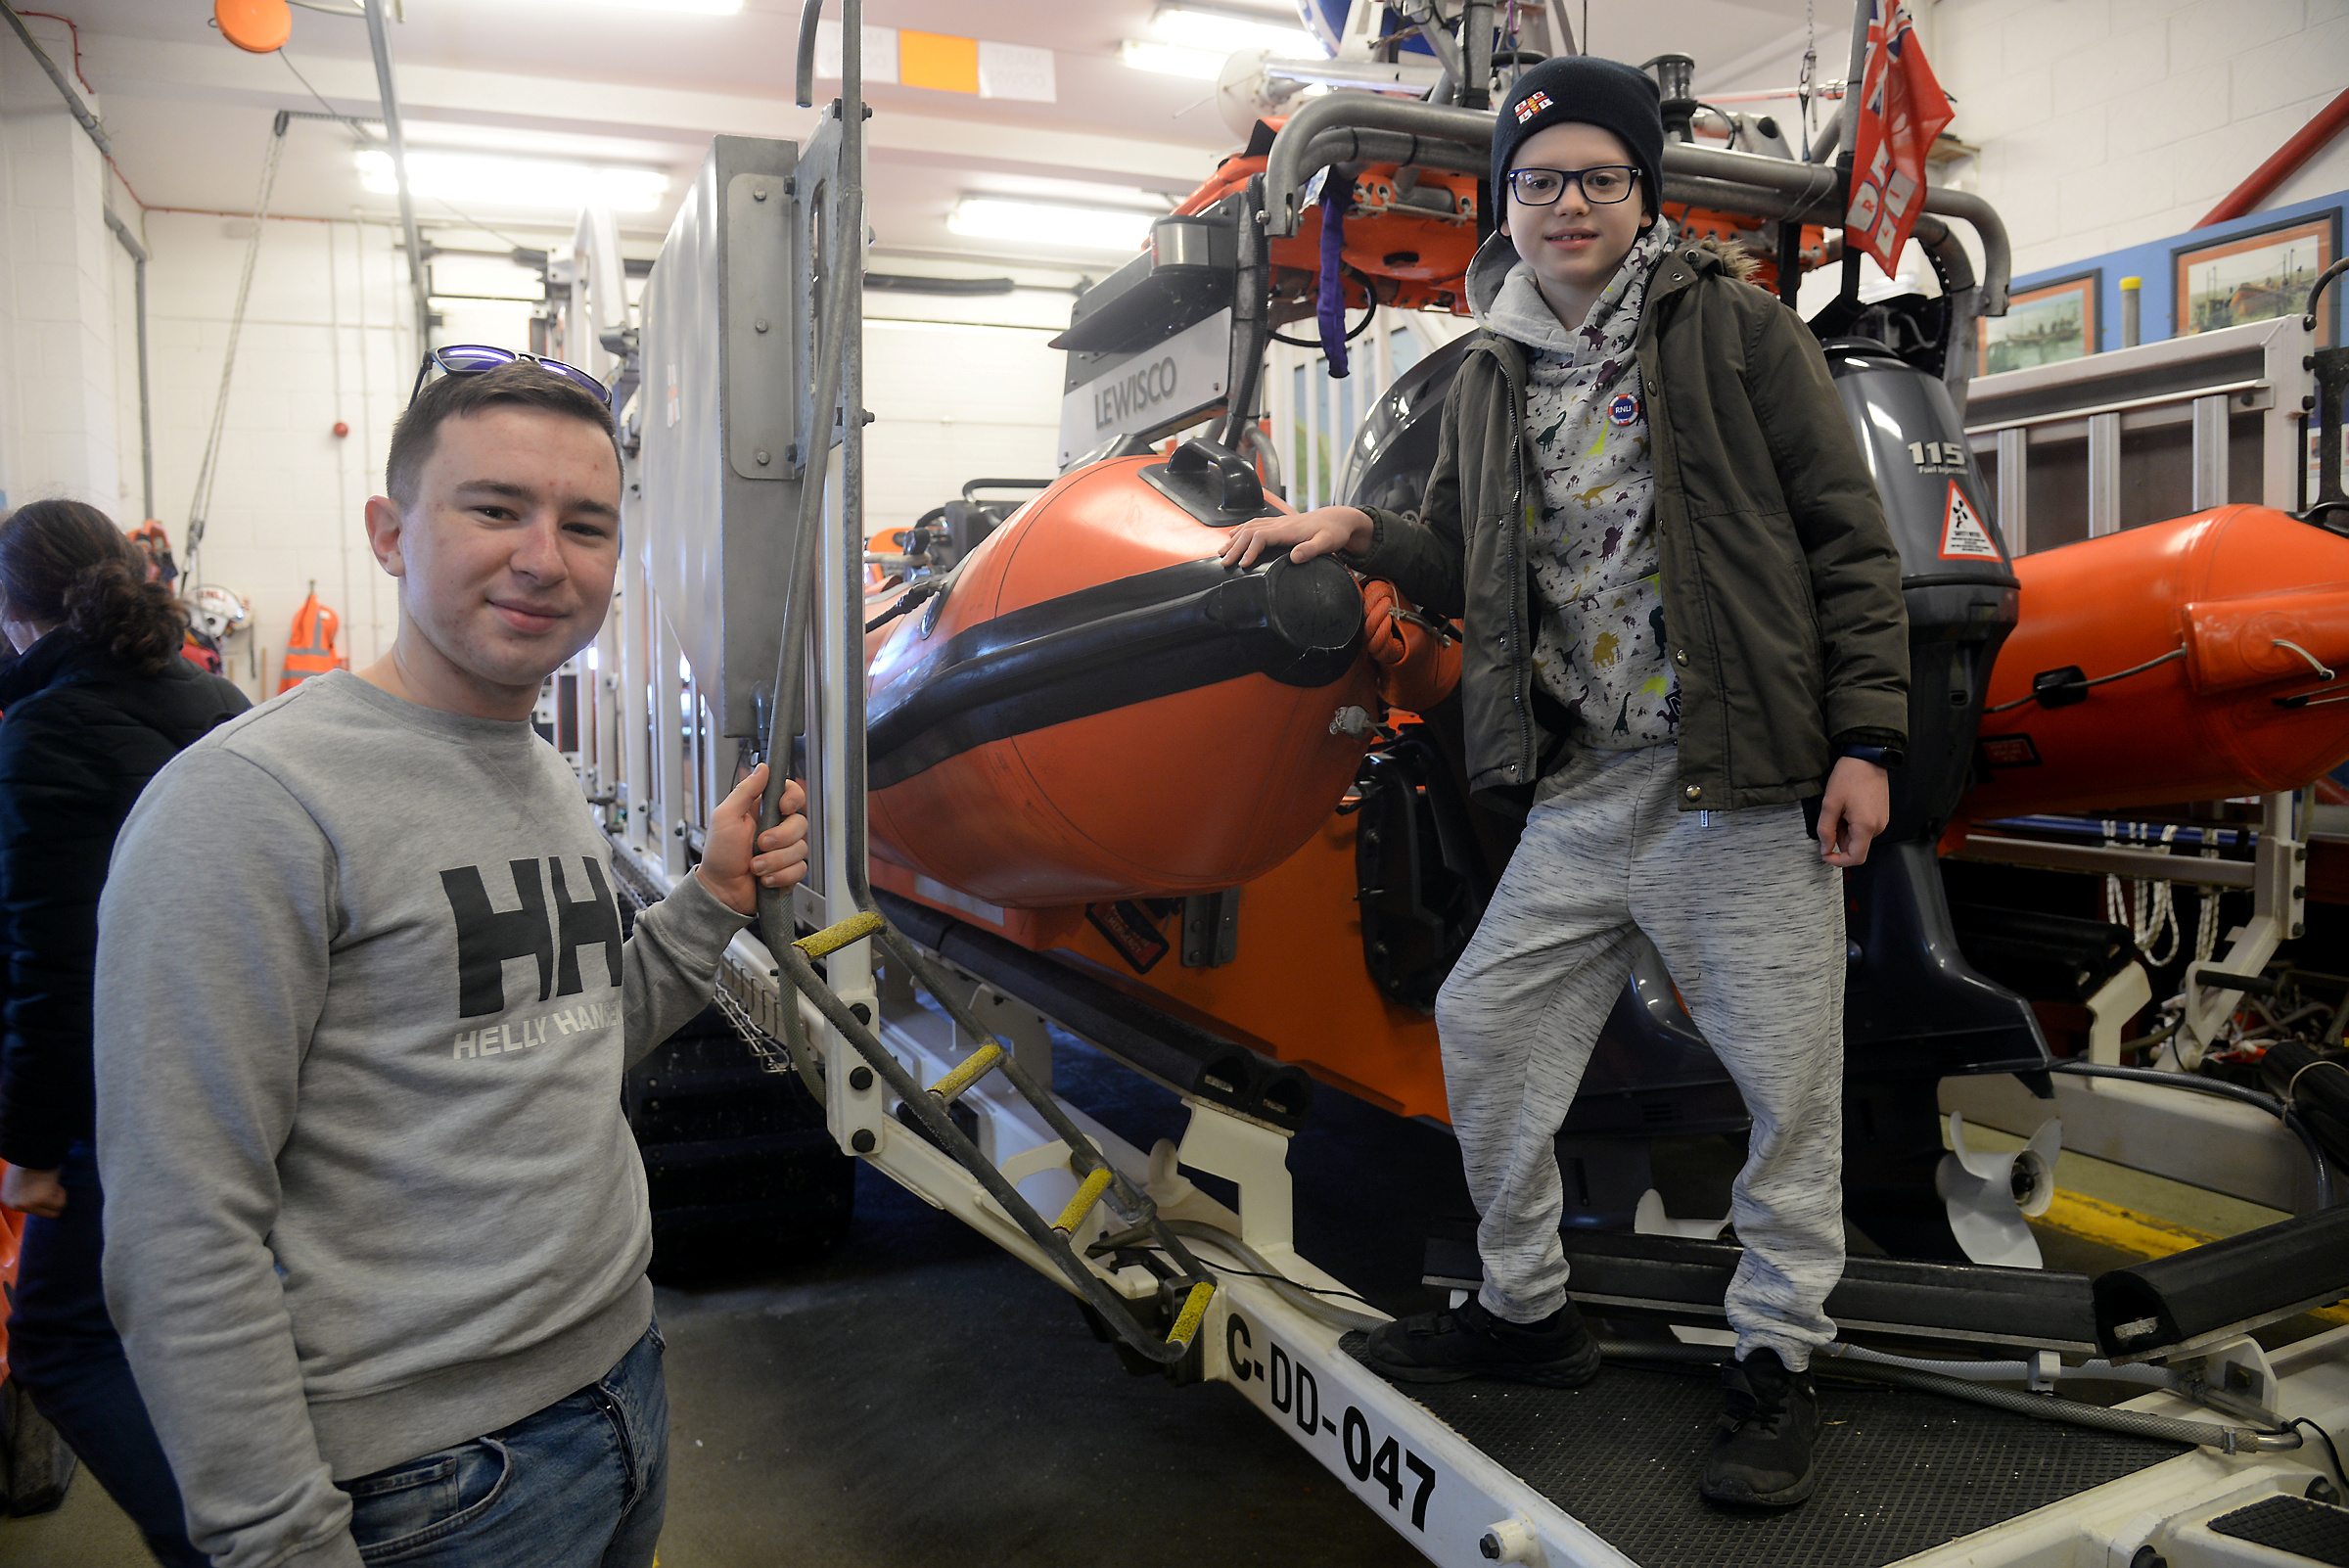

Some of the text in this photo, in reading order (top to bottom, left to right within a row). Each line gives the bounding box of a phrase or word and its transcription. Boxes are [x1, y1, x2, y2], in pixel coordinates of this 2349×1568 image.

[1094, 355, 1176, 432] LEWISCO
[1615, 405, 1632, 414] RNLI
[1908, 440, 1965, 465] 115
[438, 855, 623, 1019] HH
[453, 999, 624, 1060] HELLY HANSEN
[1226, 1313, 1436, 1534] C-DD-047
